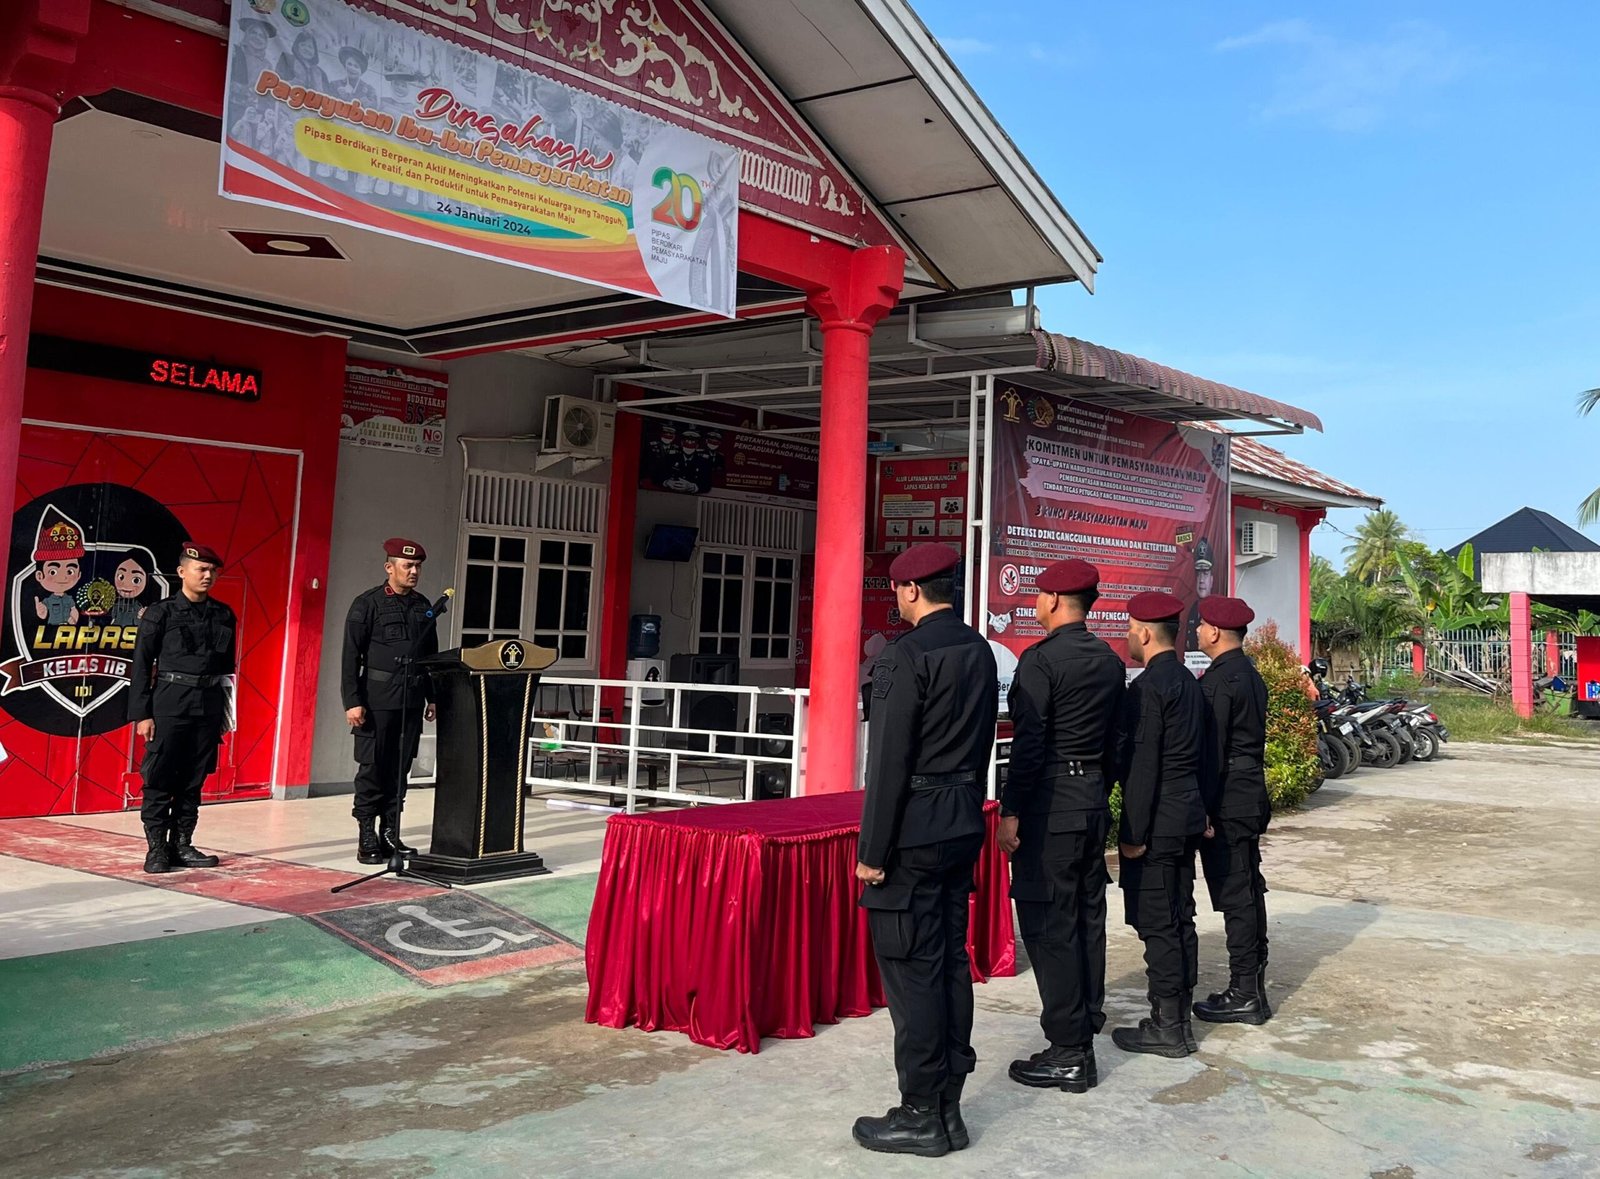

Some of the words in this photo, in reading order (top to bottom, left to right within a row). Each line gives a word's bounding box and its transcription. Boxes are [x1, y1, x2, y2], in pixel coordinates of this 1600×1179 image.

[255, 69, 394, 133] Paguyuban
[395, 114, 475, 157] Ibu-Ibu
[475, 139, 633, 206] Pemasyarakatan
[303, 125, 332, 142] Pipas
[334, 135, 380, 156] Berdikari
[381, 149, 424, 170] Berperan
[425, 161, 447, 175] Aktif
[448, 167, 506, 193] Meningkatkan
[507, 184, 538, 203] Potensi
[538, 194, 573, 214] Keluarga
[573, 205, 592, 220] yang
[592, 208, 625, 228] Tangguh,
[370, 158, 403, 178] Kreatif,
[404, 168, 422, 183] dan
[424, 174, 465, 195] Produktif
[465, 184, 490, 201] untuk
[490, 192, 556, 222] Pemasyarakatan
[557, 213, 577, 227] Maju
[651, 165, 704, 234] 20
[436, 202, 453, 216] 24
[454, 206, 501, 229] Januari
[503, 219, 533, 237] 2024
[651, 229, 672, 240] PIPAS
[650, 253, 669, 265] MAJU
[651, 245, 708, 267] PEMASYARAKATAN
[149, 359, 258, 396] SELAMA
[406, 394, 446, 410] BUDAYAKAN
[1027, 439, 1081, 460] KOMITMEN
[1081, 451, 1110, 466] UNTUK
[1111, 454, 1185, 481] PEMASYARAKATAN
[1185, 470, 1207, 484] MAJU
[1031, 456, 1070, 470] UPAYA-UPAYA
[1063, 486, 1079, 495] TEGAS
[1035, 504, 1043, 517] 3
[1007, 525, 1037, 538] DETEKSI
[1037, 529, 1056, 541] DINI
[1056, 532, 1092, 546] GANGGUAN
[1092, 536, 1129, 550] KEAMANAN
[1129, 541, 1143, 551] DAN
[1142, 542, 1177, 555] KETERTIBAN
[1019, 565, 1047, 576] BERANT
[1015, 607, 1036, 618] SINER
[33, 624, 139, 650] LAPAS
[42, 659, 100, 679] KELAS
[103, 660, 128, 676] IIB
[74, 685, 93, 698] IDI
